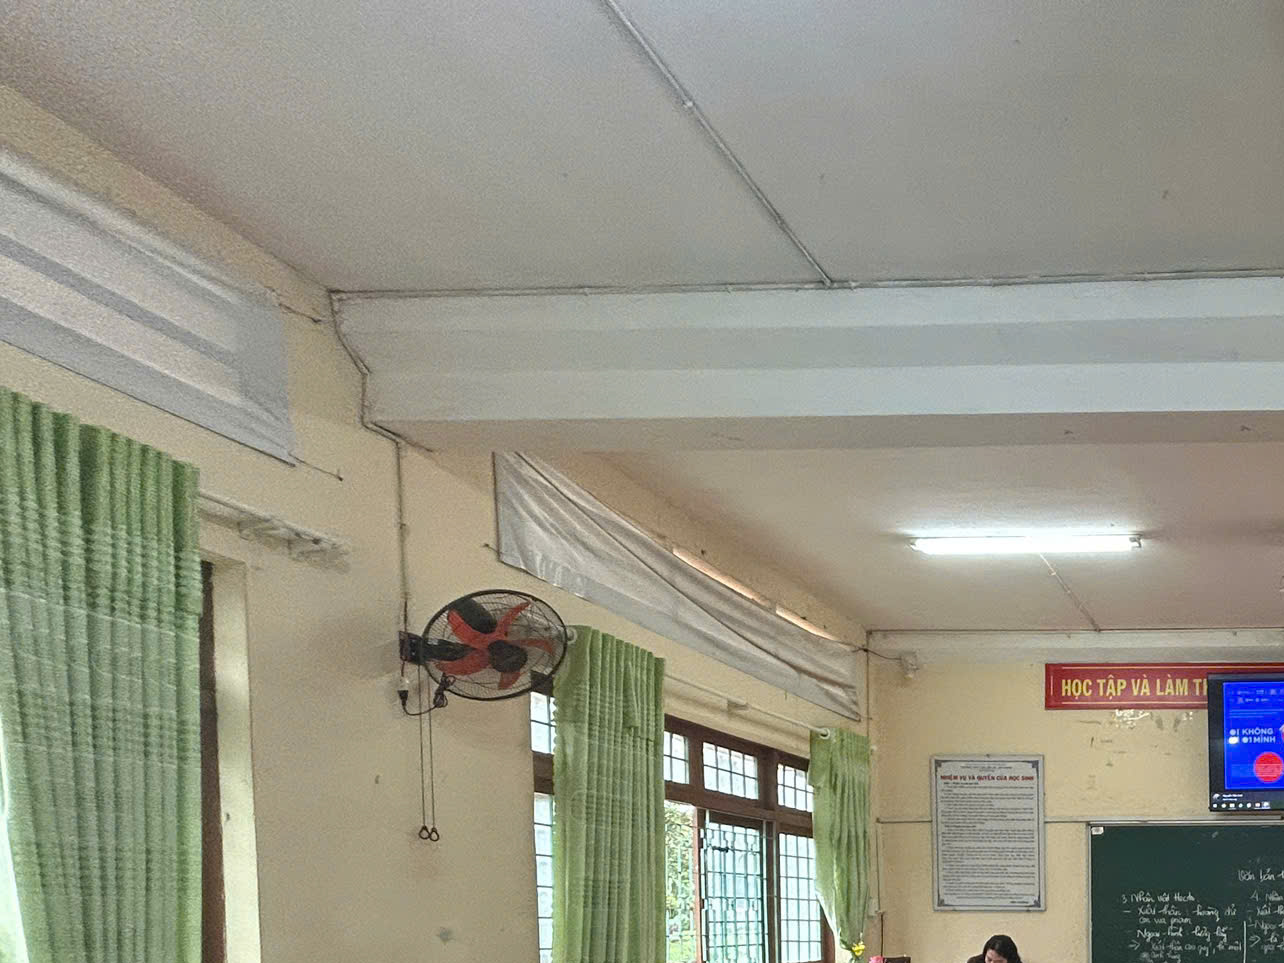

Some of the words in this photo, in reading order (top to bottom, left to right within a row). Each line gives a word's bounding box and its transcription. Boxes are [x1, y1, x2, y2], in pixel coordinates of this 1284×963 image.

[1061, 678, 1093, 700] HỌC
[1096, 674, 1127, 700] TẬP
[1131, 673, 1151, 696] VÀ
[1156, 673, 1189, 696] LÀM
[1242, 727, 1274, 736] KHÔNG
